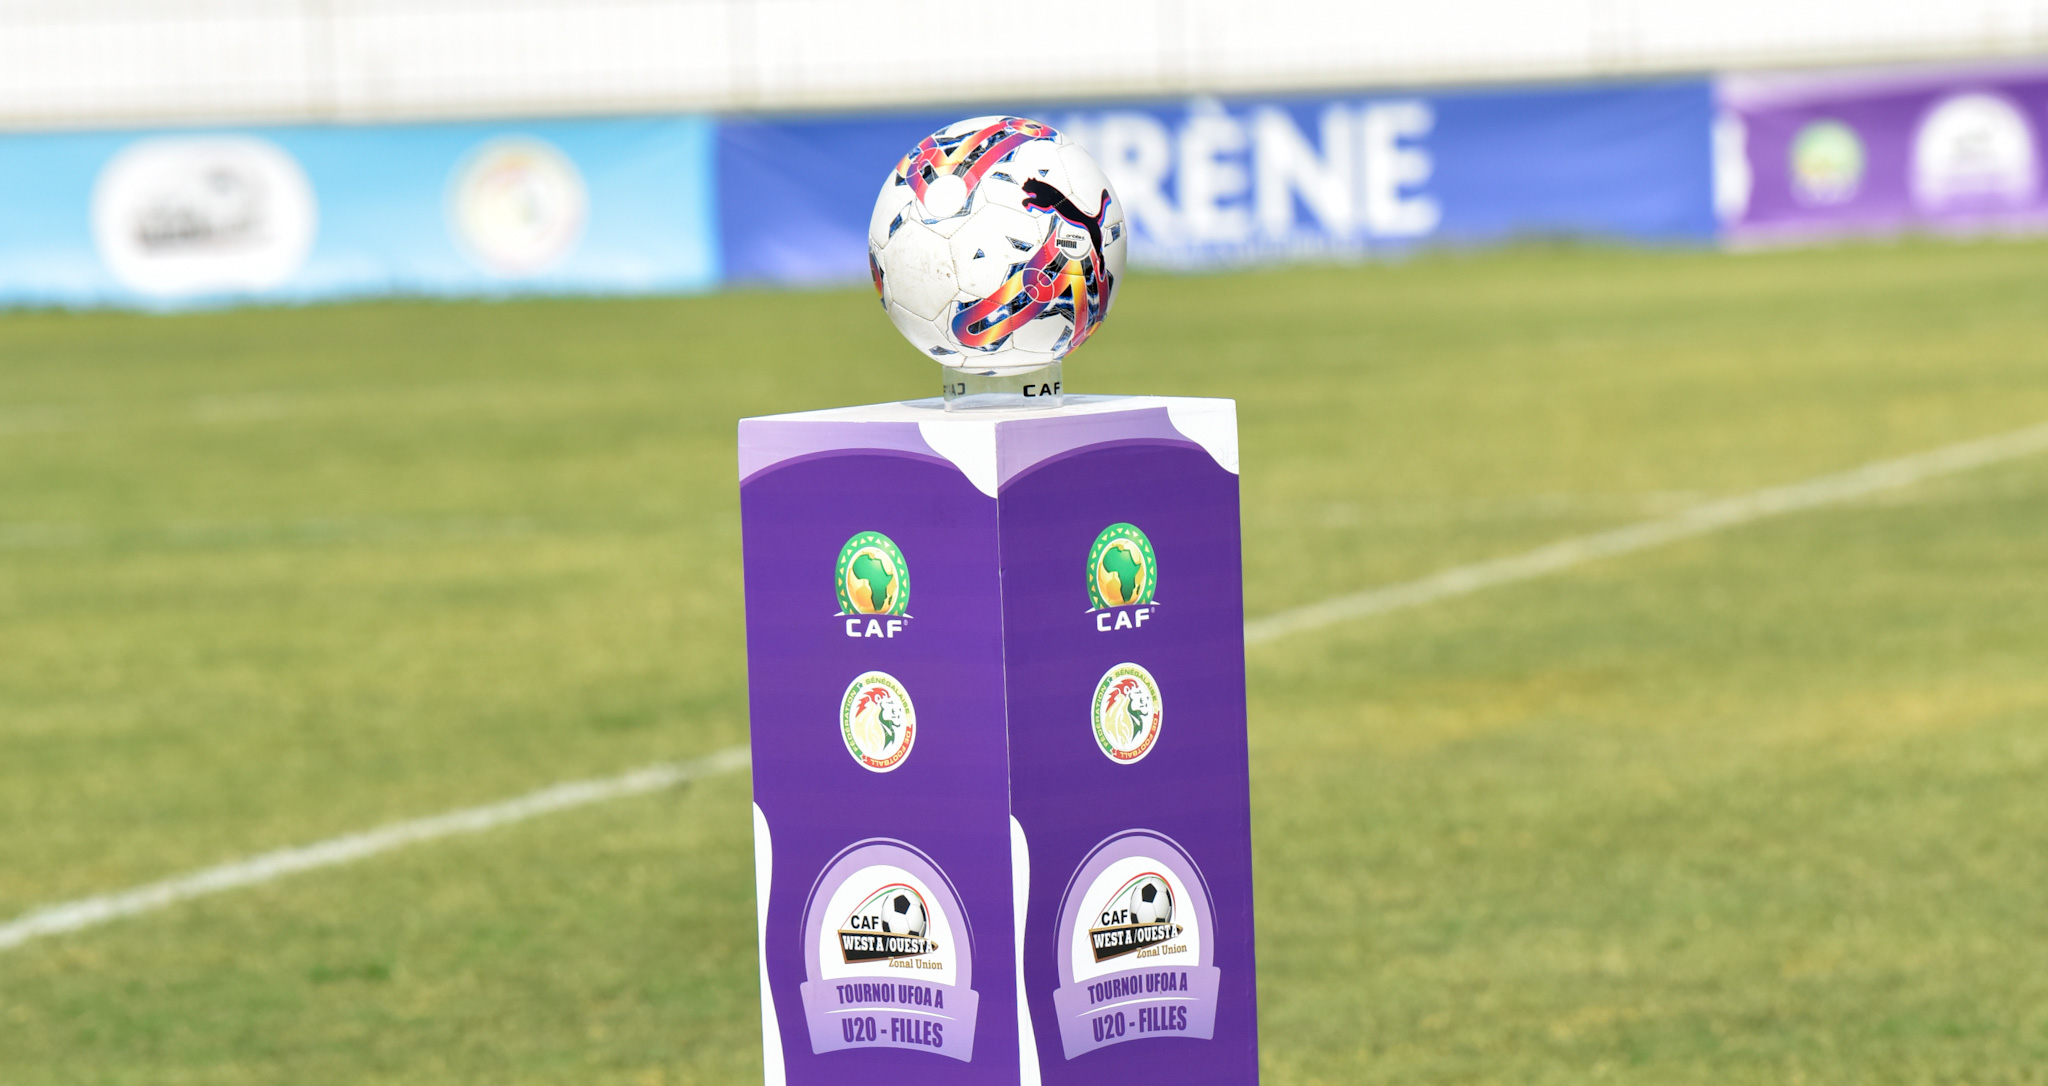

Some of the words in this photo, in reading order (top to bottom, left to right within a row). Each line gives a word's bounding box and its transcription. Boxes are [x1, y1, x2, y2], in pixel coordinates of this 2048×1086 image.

[1056, 239, 1077, 249] PUMA
[1023, 381, 1061, 397] CAF
[846, 618, 902, 638] CAF
[1096, 608, 1150, 632] CAF
[866, 676, 910, 714] SÉNÉGALAISE
[1115, 668, 1157, 702] SÉNÉGALAISE
[870, 744, 907, 766] FOOTBALL
[1120, 733, 1154, 758] FOOTBALL
[851, 915, 880, 930] CAF
[1101, 909, 1128, 926] CAF
[1136, 946, 1160, 958] Zonal
[1162, 944, 1188, 955] Union
[888, 956, 914, 969] Zonal
[915, 959, 943, 970] Union
[836, 983, 895, 1004] TOURNOI
[898, 984, 932, 1007] UFOA
[934, 989, 944, 1009] A
[1087, 974, 1143, 1004] TOURNOI
[1146, 972, 1177, 993] UFOA
[1179, 972, 1188, 991] A
[842, 1016, 877, 1043] U20
[891, 1017, 943, 1048] FILLES
[1092, 1011, 1126, 1042] U20
[1139, 1005, 1187, 1033] FILLES
